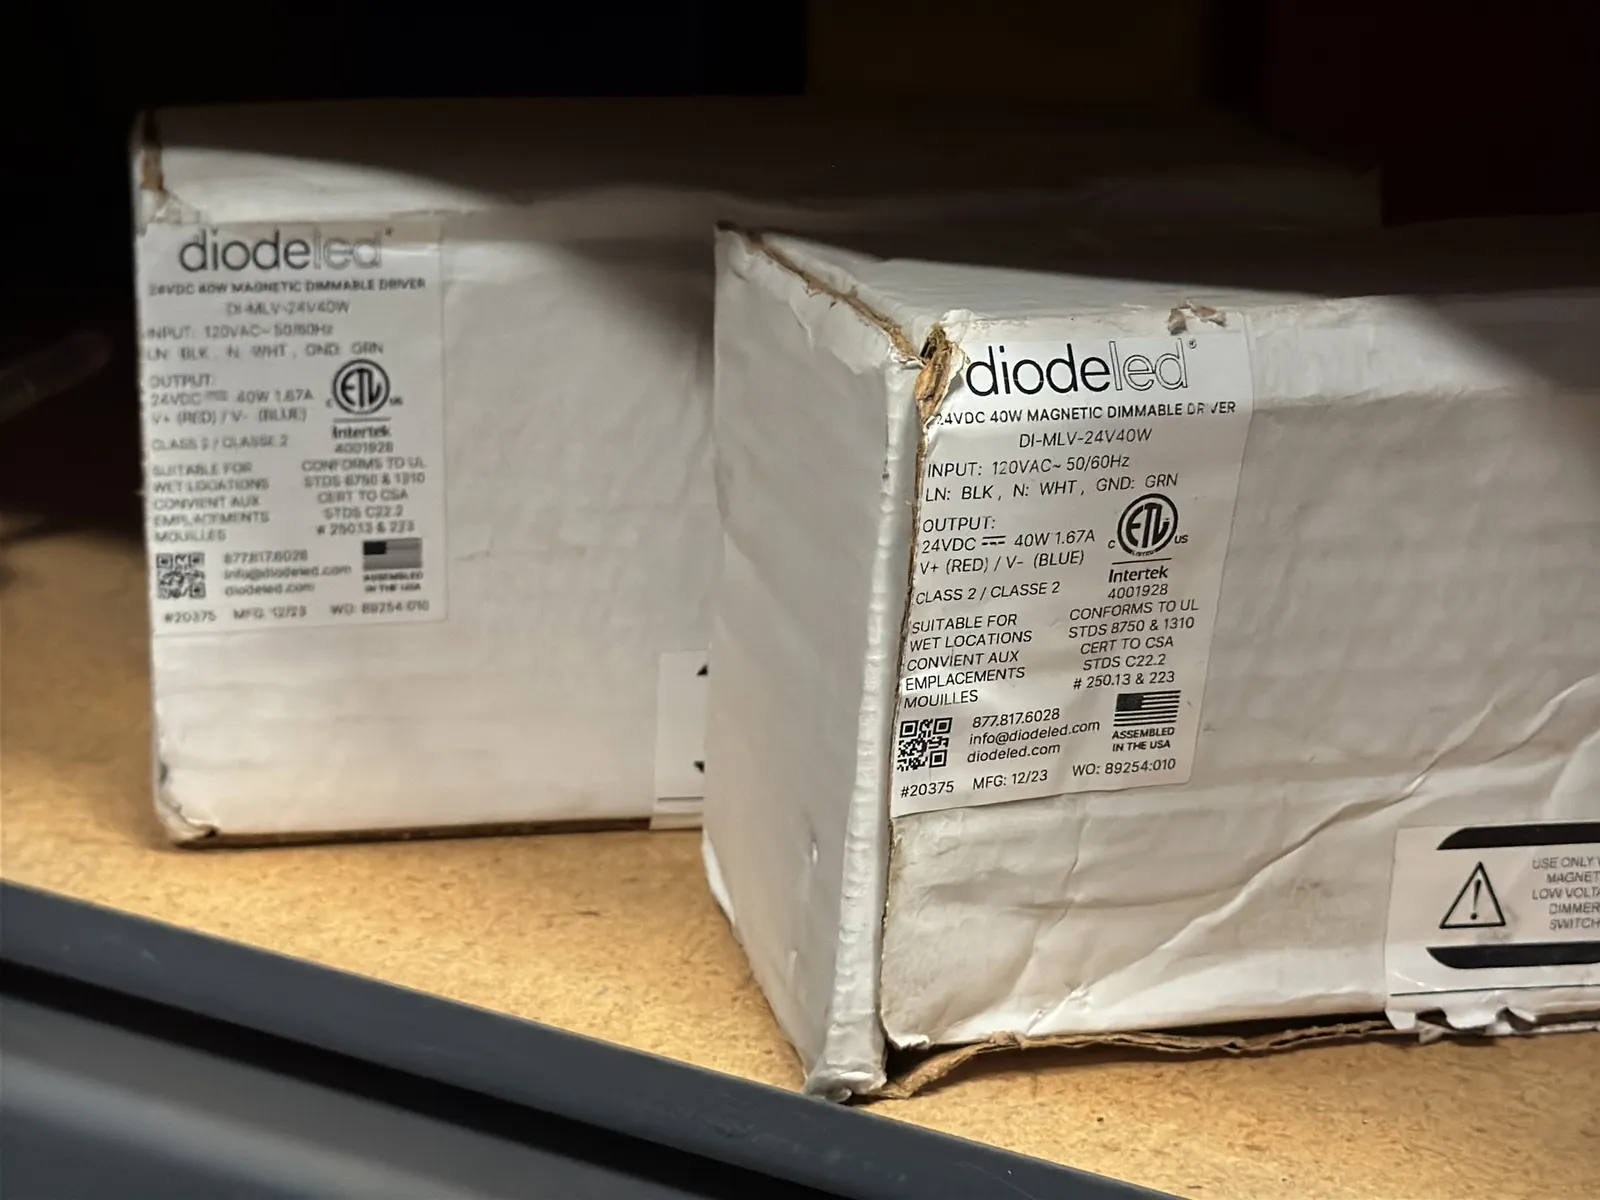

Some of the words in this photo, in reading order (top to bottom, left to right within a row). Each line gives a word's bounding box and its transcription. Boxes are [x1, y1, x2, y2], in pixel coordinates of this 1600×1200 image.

[147, 283, 196, 296] 24VDC
[198, 283, 228, 294] 40W
[231, 281, 302, 293] MAGNETIC
[305, 279, 376, 292] DIMMABLE
[379, 278, 426, 291] DRIVER
[990, 408, 1023, 422] 40W
[1027, 406, 1103, 421] MAGNETIC
[1107, 402, 1182, 418] DIMMABLE
[1187, 401, 1236, 416] DRVER
[333, 425, 391, 438] Intertek
[1019, 428, 1152, 448] DI-MLV-24V40W
[153, 463, 218, 477] SUITABLE
[223, 462, 252, 474] FOR
[302, 458, 383, 472] CONFORMS
[387, 457, 405, 469] TO
[407, 456, 427, 469] UL
[928, 462, 982, 478] INPUT:
[1066, 455, 1129, 471] 50/60Hz
[153, 480, 185, 493] WET
[188, 478, 269, 492] LOCATIONS
[925, 487, 951, 502] LN:
[1013, 483, 1030, 498] N:
[1096, 476, 1135, 492] GND:
[1145, 473, 1178, 489] GRN
[922, 516, 996, 533] OUTPUT:
[922, 537, 976, 554] 24VDC
[1014, 532, 1050, 547] 40W
[1055, 529, 1095, 545] 1.67A
[920, 562, 939, 575] V+
[946, 556, 988, 575] (RED)
[1033, 550, 1084, 569] (BLUE)
[1108, 565, 1168, 583] Intertek
[916, 589, 963, 605] CLASS
[967, 587, 976, 601] 2
[990, 582, 1048, 598] CLASSE
[1051, 581, 1061, 594] 2
[1108, 583, 1168, 600] 4001928
[1069, 601, 1153, 621] CONFORMS
[1158, 600, 1177, 614] TO
[1179, 598, 1199, 612] UL
[911, 616, 984, 634] SUITABLE
[987, 613, 1017, 628] FOR
[1068, 622, 1107, 639] STDS
[1110, 619, 1145, 634] 8750
[1149, 618, 1159, 632] &
[1163, 616, 1195, 630] 1310
[909, 637, 942, 652] WET
[945, 630, 1033, 648] LOCATIONS
[1080, 640, 1117, 655] CERT
[1122, 638, 1141, 652] TO
[1145, 636, 1174, 650] CSA
[906, 654, 985, 672] CONVIENT
[987, 650, 1020, 665] AUX
[1082, 656, 1122, 671] STDS
[1125, 653, 1166, 668] C22.2
[905, 667, 1026, 691] EMPLACEMENTS
[1073, 678, 1082, 690] #
[1086, 674, 1131, 689] 250.13
[1135, 673, 1145, 686] &
[1149, 671, 1175, 685] 223
[904, 690, 979, 709] MOUILLES
[972, 707, 1060, 729] 877.817.6028
[969, 720, 1100, 746] info@diodeled.com
[1112, 727, 1175, 740] ASSEMBLED
[967, 742, 1060, 763] diodeled.com
[1112, 743, 1125, 753] IN
[1127, 741, 1147, 751] THE
[1149, 739, 1171, 750] USA
[1072, 763, 1100, 777] WO:
[1104, 758, 1177, 775] 89254:010
[900, 780, 954, 798] #20375
[973, 775, 1007, 791] MFG:
[1011, 769, 1048, 786] 12/23
[1532, 856, 1558, 869] USE
[1561, 856, 1594, 868] ONLY
[1532, 887, 1562, 900] LOW
